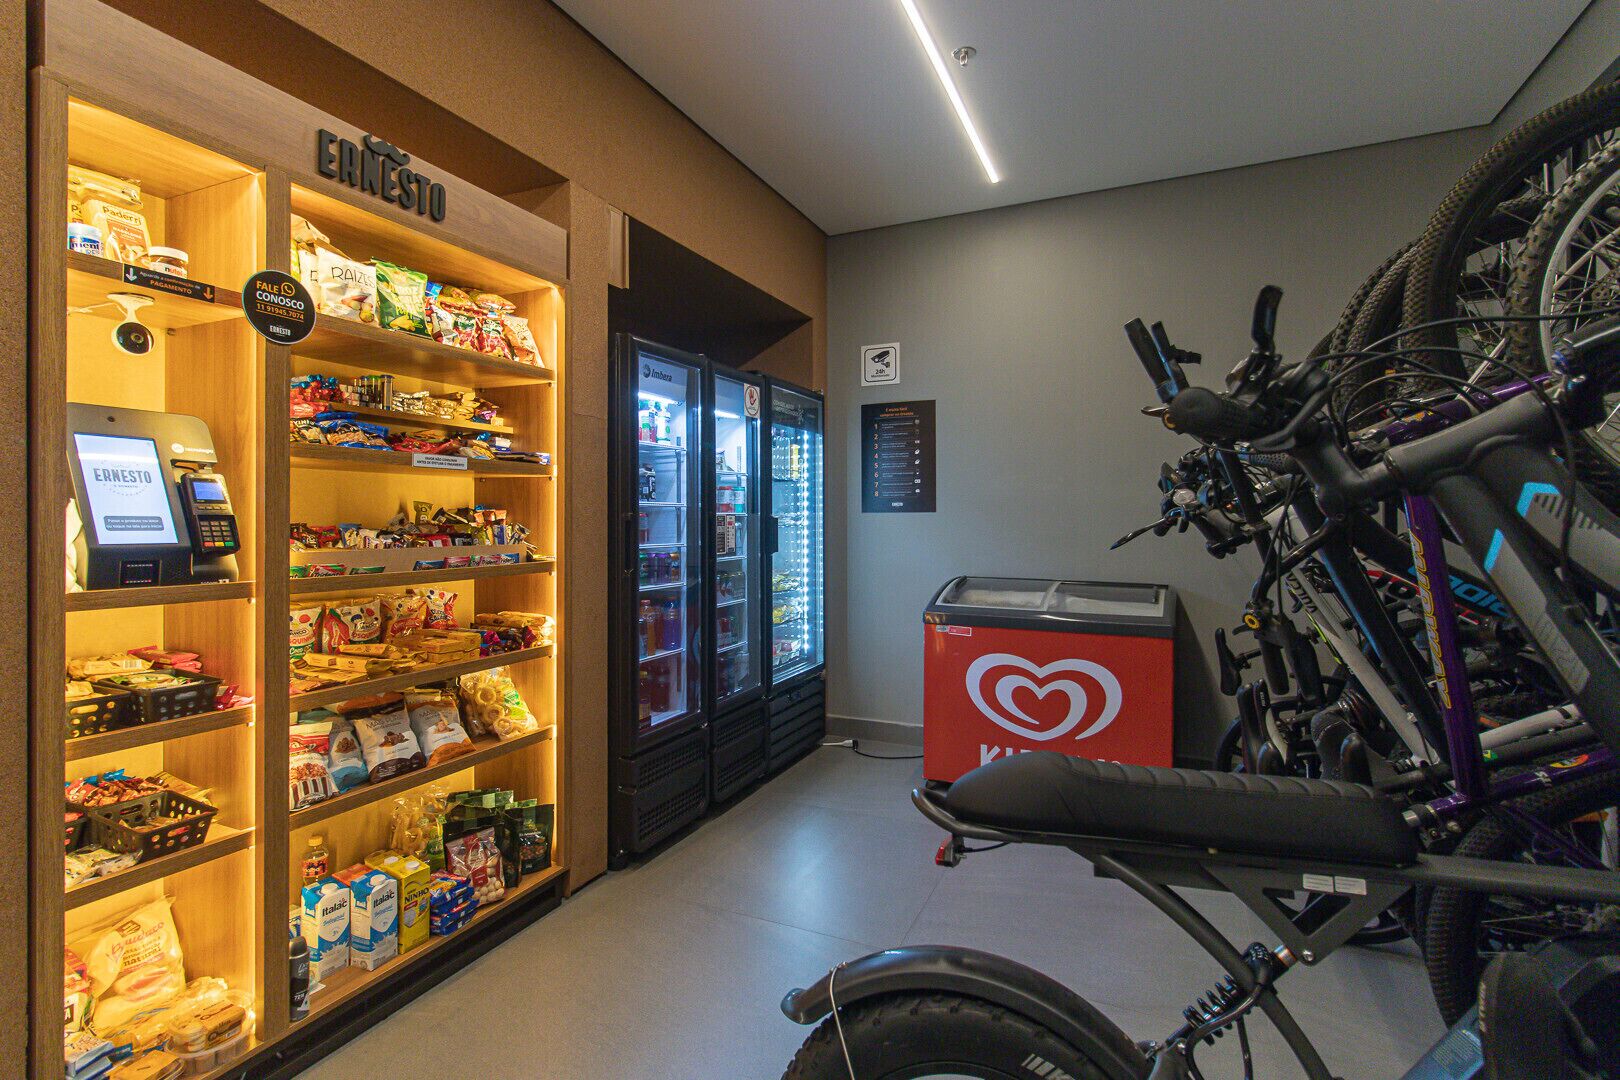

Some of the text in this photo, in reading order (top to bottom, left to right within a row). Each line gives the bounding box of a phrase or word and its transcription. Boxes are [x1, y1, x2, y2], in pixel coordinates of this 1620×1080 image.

[318, 128, 447, 222] ERNESTO
[150, 279, 192, 294] PAGAMENTO
[256, 280, 279, 294] FALE
[256, 290, 305, 310] CONOSCO
[93, 468, 152, 484] ERNESTO
[404, 887, 430, 904] NINHO
[321, 900, 348, 917] Italac
